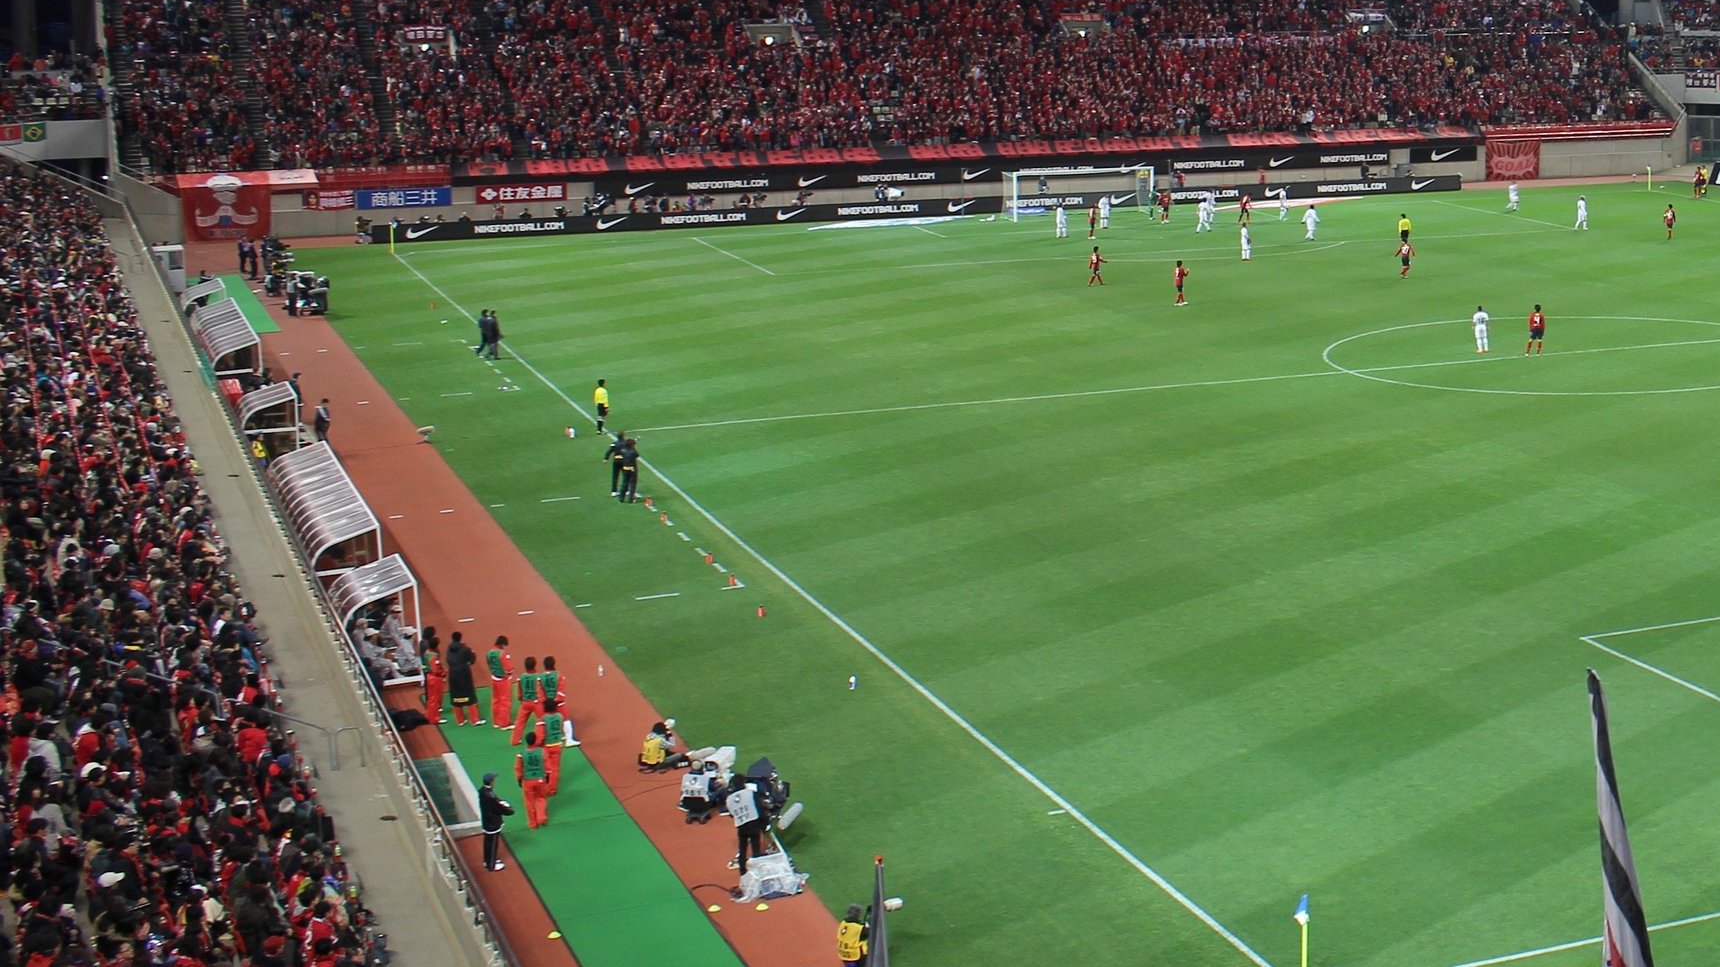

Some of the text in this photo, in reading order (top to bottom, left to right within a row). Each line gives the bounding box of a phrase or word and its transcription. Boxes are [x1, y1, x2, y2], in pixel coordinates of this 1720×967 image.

[1173, 159, 1245, 170] NIKEFOOTBALL.COM
[1319, 153, 1388, 165] NIKEFOOTBALL.COM
[687, 178, 769, 190] NIKEFOOTBALL.COM
[857, 172, 935, 184] NIKEFOOTBALL.COM
[1317, 182, 1387, 194] NIKEFOOTBALL.COM
[371, 189, 437, 207] 商船三井
[837, 203, 919, 216] NIKEFOOTBALL.COM
[660, 212, 746, 225] NIKEFOOTBALL.COM
[474, 221, 564, 234] NIKEFOOTBALL.COM
